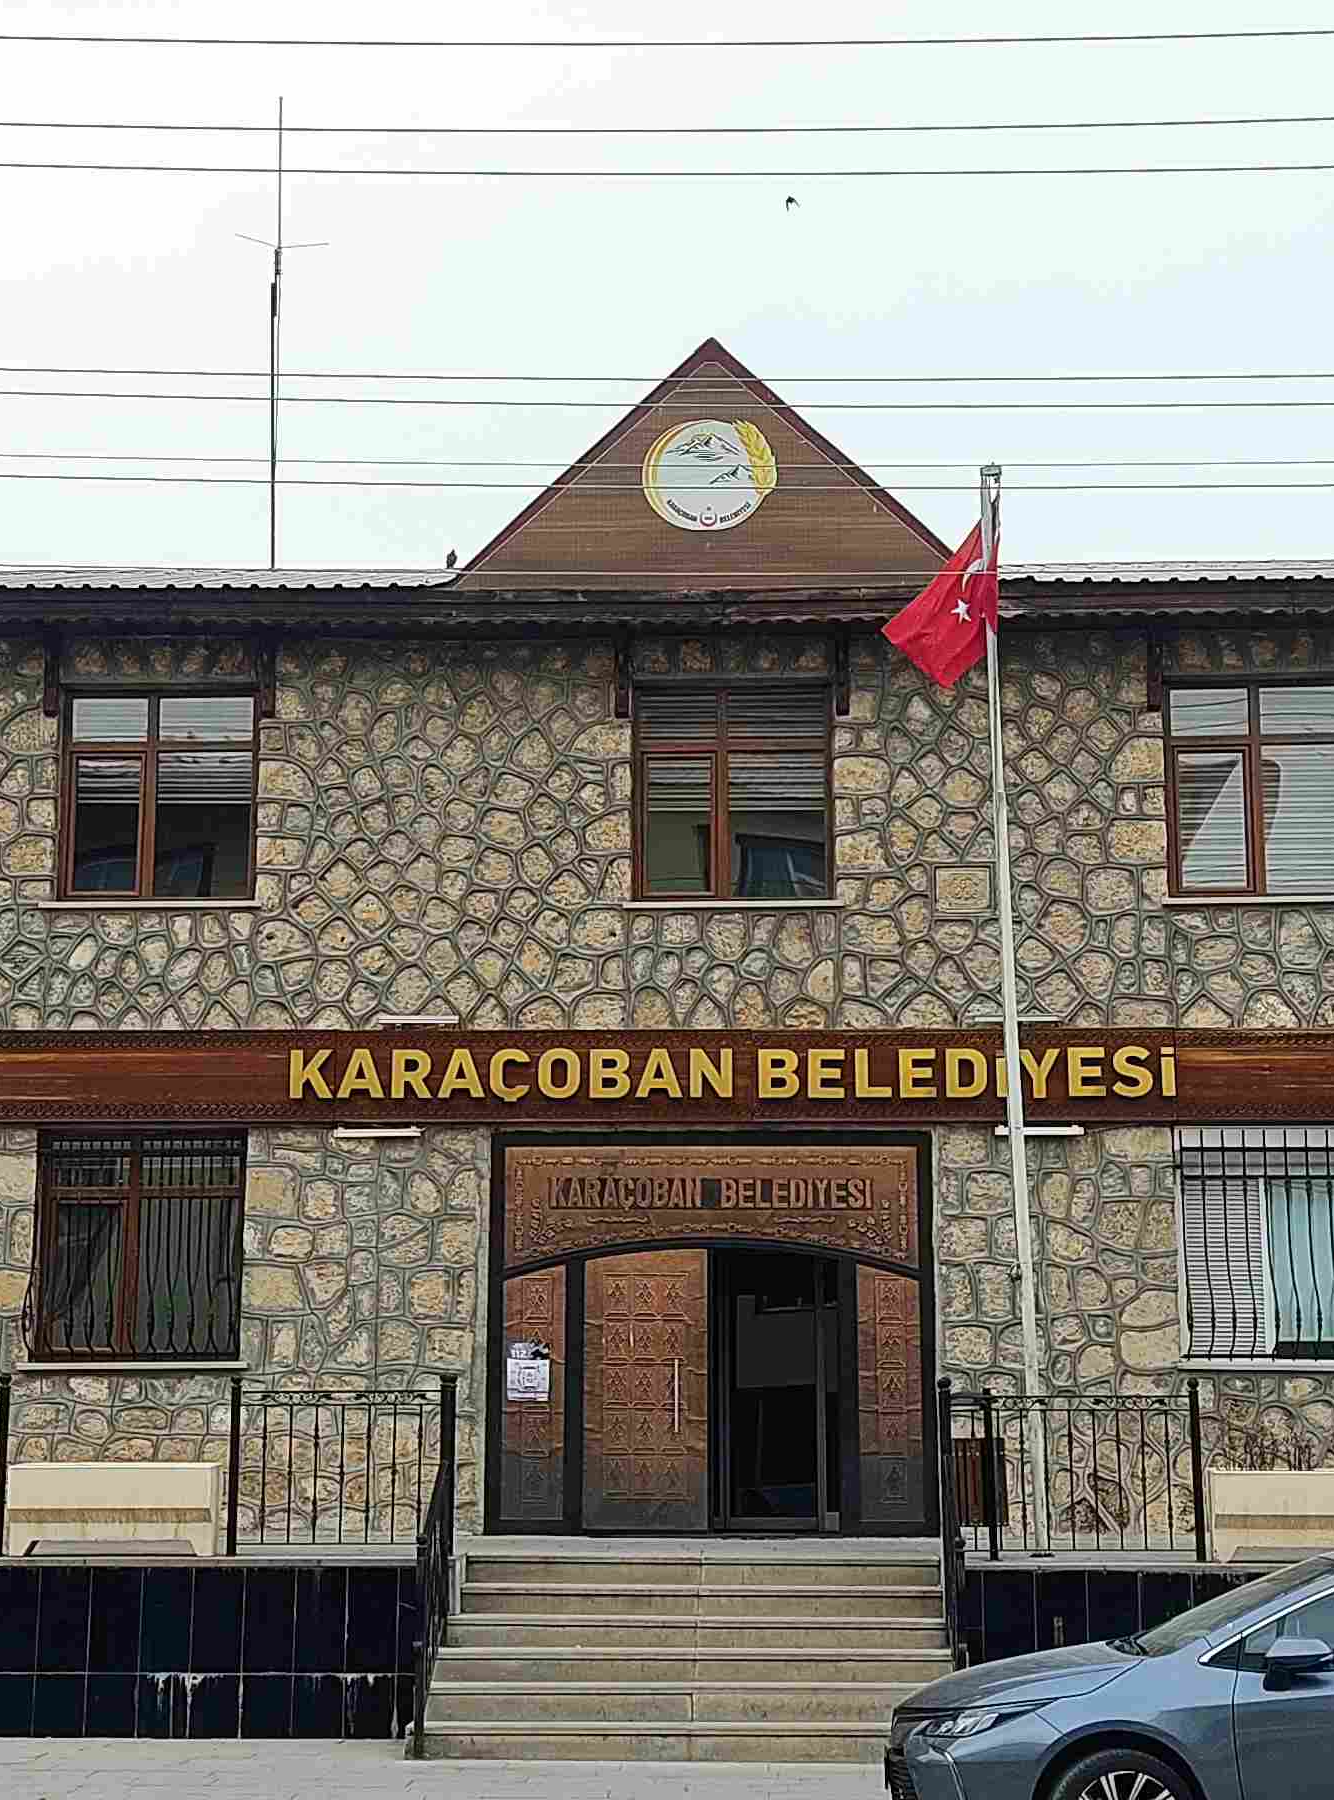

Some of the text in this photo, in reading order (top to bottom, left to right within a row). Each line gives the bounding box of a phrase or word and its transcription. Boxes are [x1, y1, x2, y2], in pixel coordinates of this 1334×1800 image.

[288, 1045, 1177, 1103] KARAÇOBAN BELEDİYESİ
[547, 1176, 701, 1211] KARAÇOBAN
